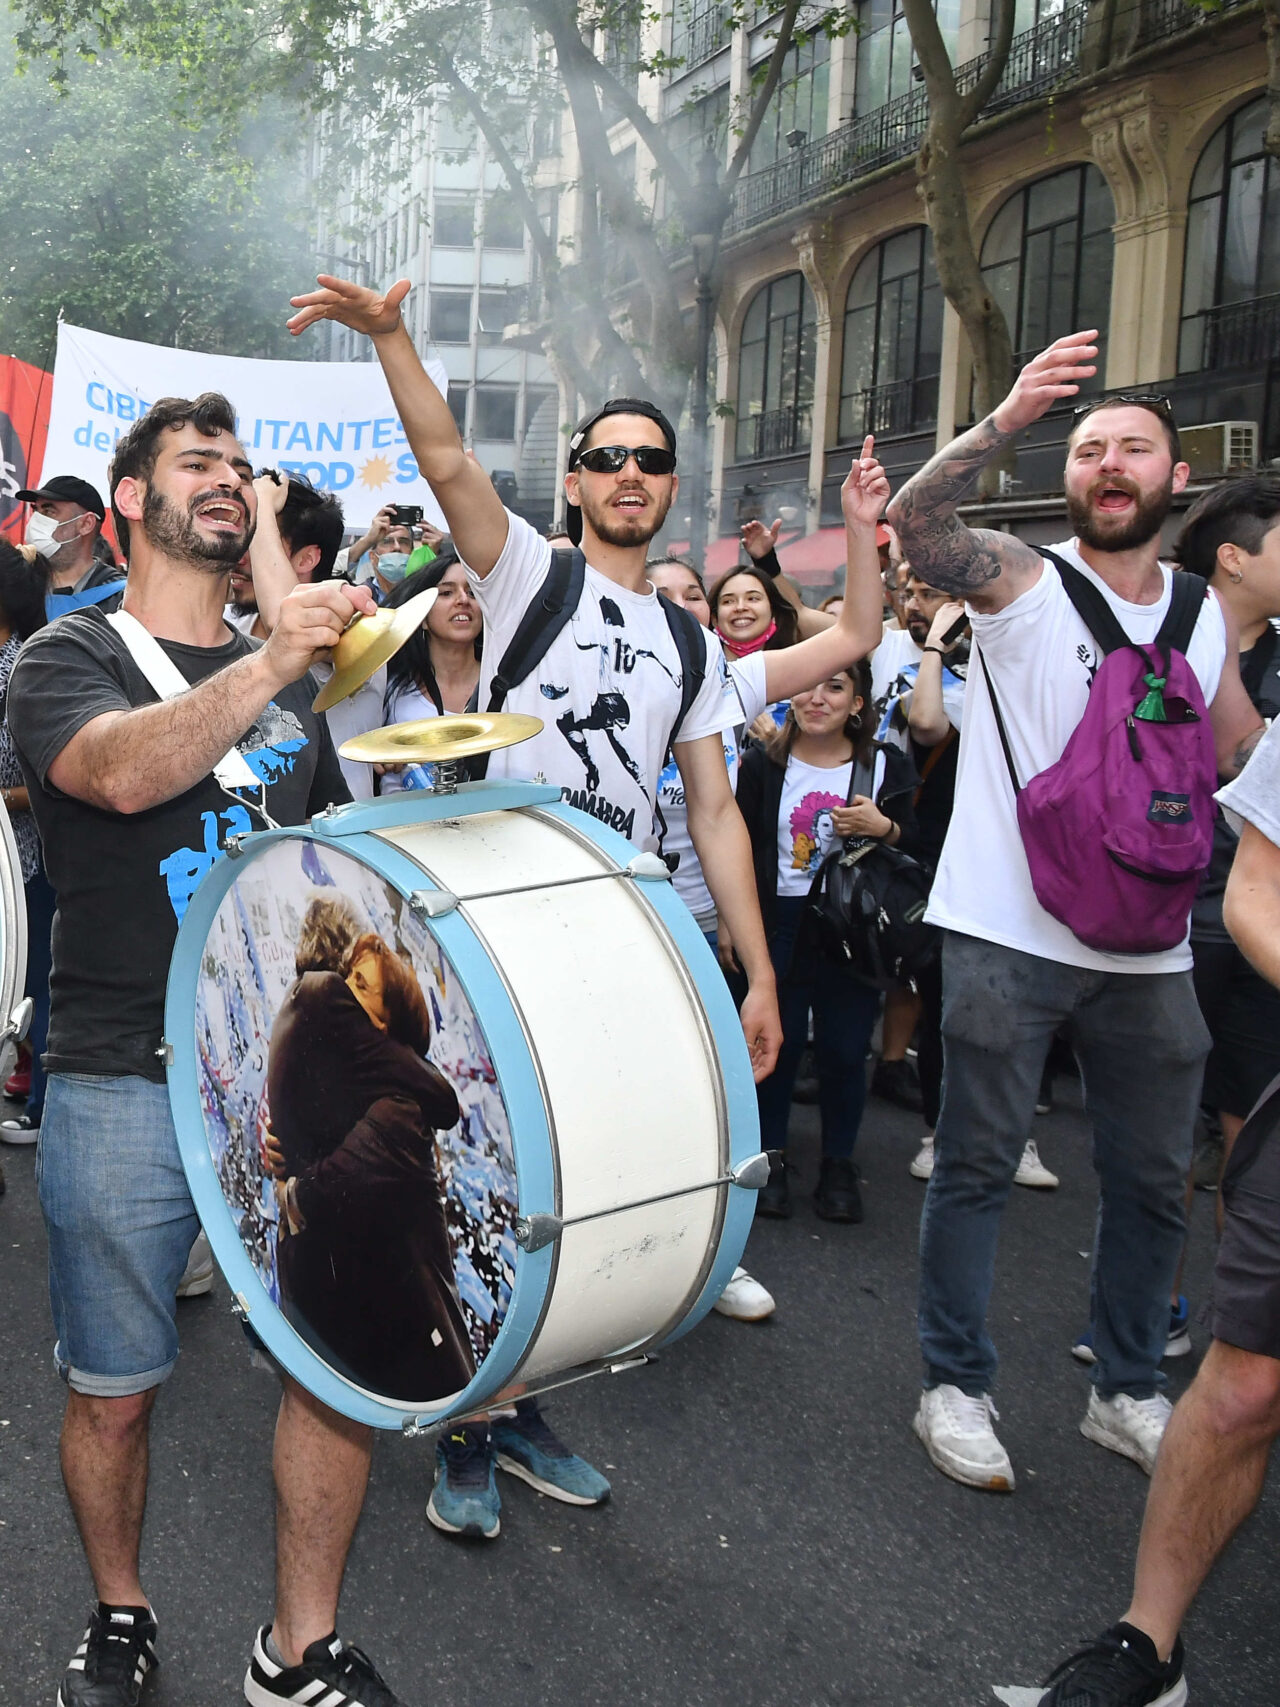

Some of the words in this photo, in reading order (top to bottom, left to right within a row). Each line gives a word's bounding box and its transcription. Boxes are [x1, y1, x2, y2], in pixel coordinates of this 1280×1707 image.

[614, 637, 636, 674] 10
[663, 786, 684, 797] VIC
[670, 795, 686, 806] LO
